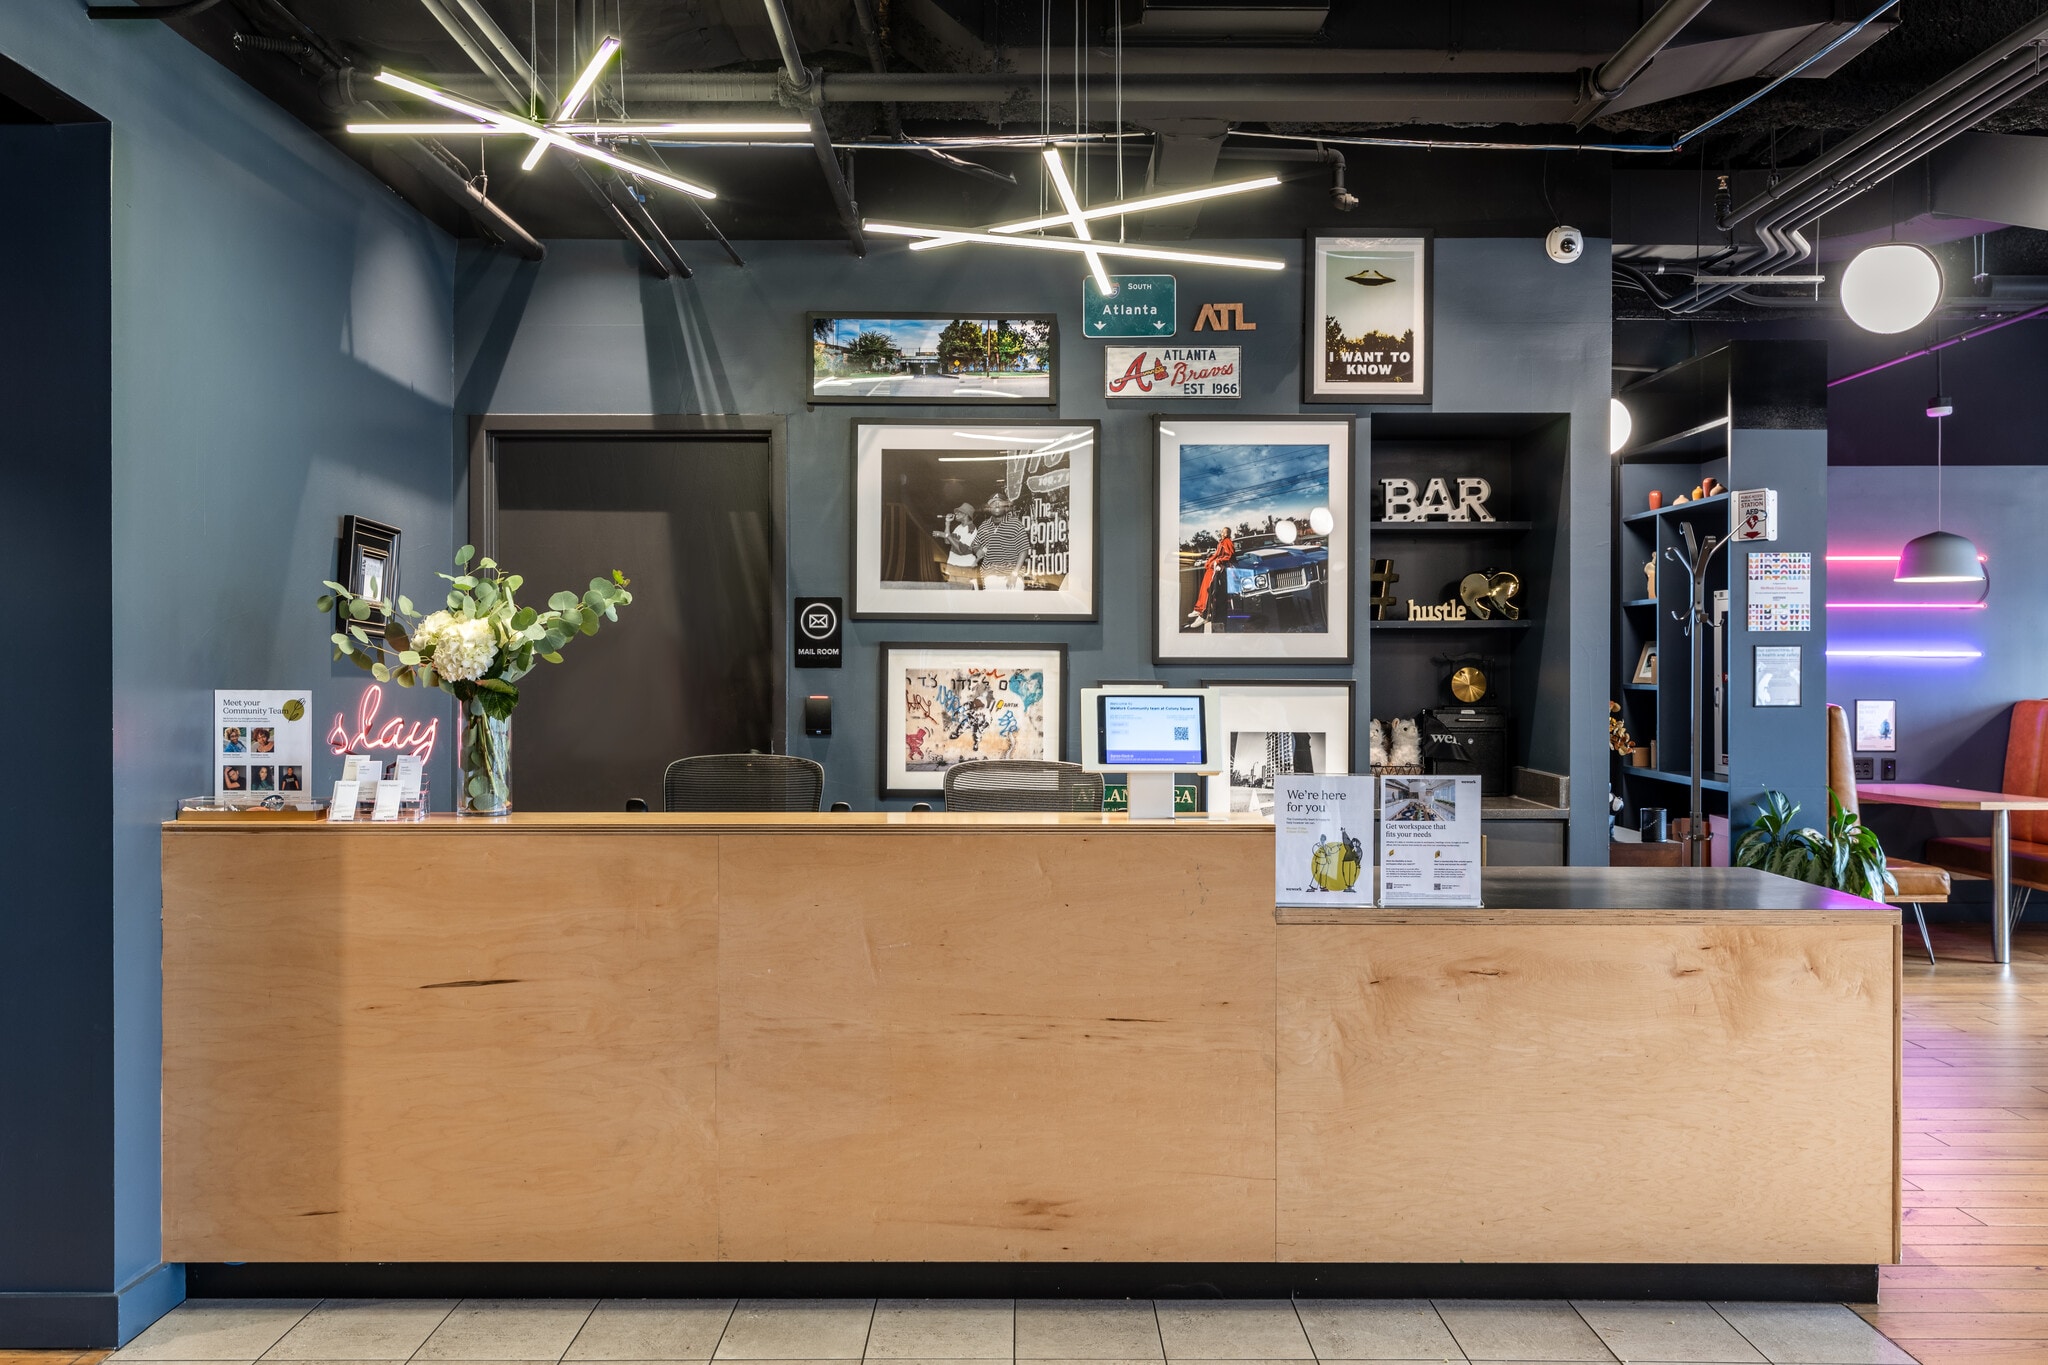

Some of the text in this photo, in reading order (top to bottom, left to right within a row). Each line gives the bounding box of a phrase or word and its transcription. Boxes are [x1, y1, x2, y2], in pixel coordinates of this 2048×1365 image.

[1127, 282, 1152, 290] SOUTH
[1102, 304, 1158, 315] Atlanta
[1193, 302, 1257, 331] ATL
[1163, 349, 1217, 361] ATLANTA
[1329, 351, 1411, 363] I WANT TO
[1170, 361, 1234, 387] Braves
[1346, 364, 1393, 375] KNOW
[1183, 383, 1238, 395] EST 1966
[1379, 477, 1497, 522] BAR
[1740, 500, 1764, 508] STATION
[1033, 498, 1051, 518] The
[1406, 598, 1467, 621] hustle
[243, 700, 261, 708] your
[222, 707, 289, 716] Community Team
[327, 684, 439, 767] slay
[1321, 790, 1347, 801] here
[1286, 802, 1326, 815] for you
[1398, 822, 1433, 832] workspace
[1385, 830, 1432, 840] fits your needs
